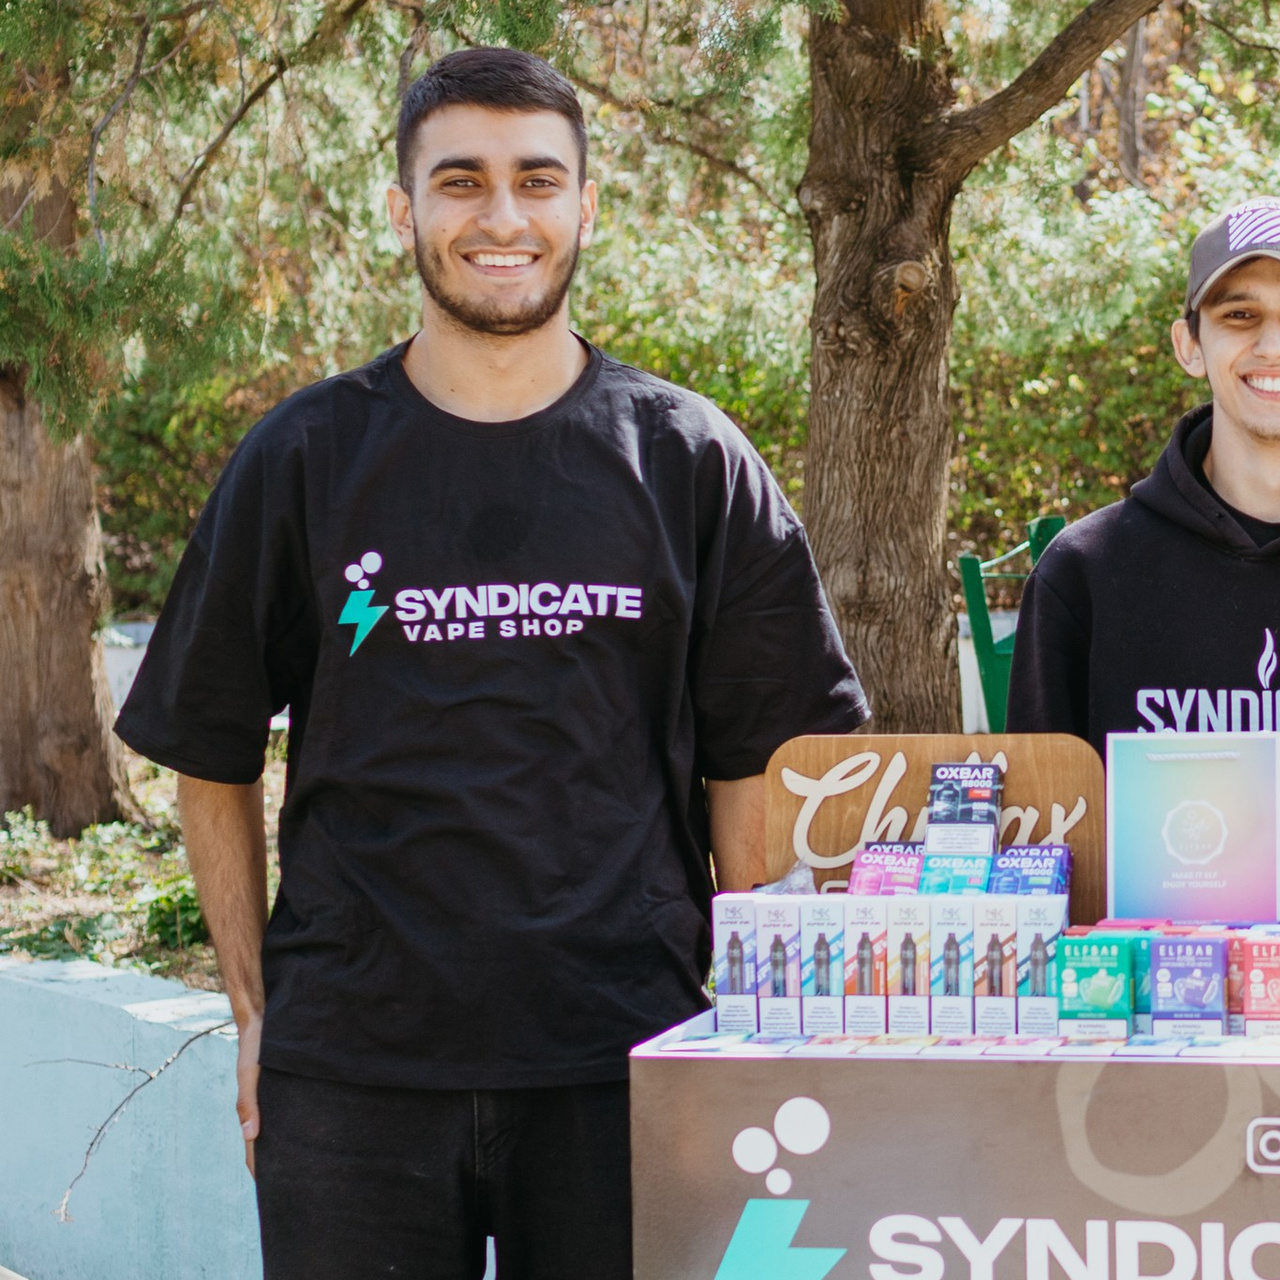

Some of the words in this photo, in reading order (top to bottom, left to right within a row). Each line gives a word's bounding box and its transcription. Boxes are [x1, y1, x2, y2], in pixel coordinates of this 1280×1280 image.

[395, 583, 642, 621] SYNDICATE
[403, 622, 485, 641] VAPE
[500, 619, 584, 638] SHOP
[936, 767, 994, 779] OXBAR
[860, 853, 920, 867] OXBAR
[928, 856, 987, 869] OXBAR
[997, 856, 1056, 869] OXBAR
[1064, 945, 1119, 956] ELFBAR
[1159, 945, 1213, 956] ELFBAR
